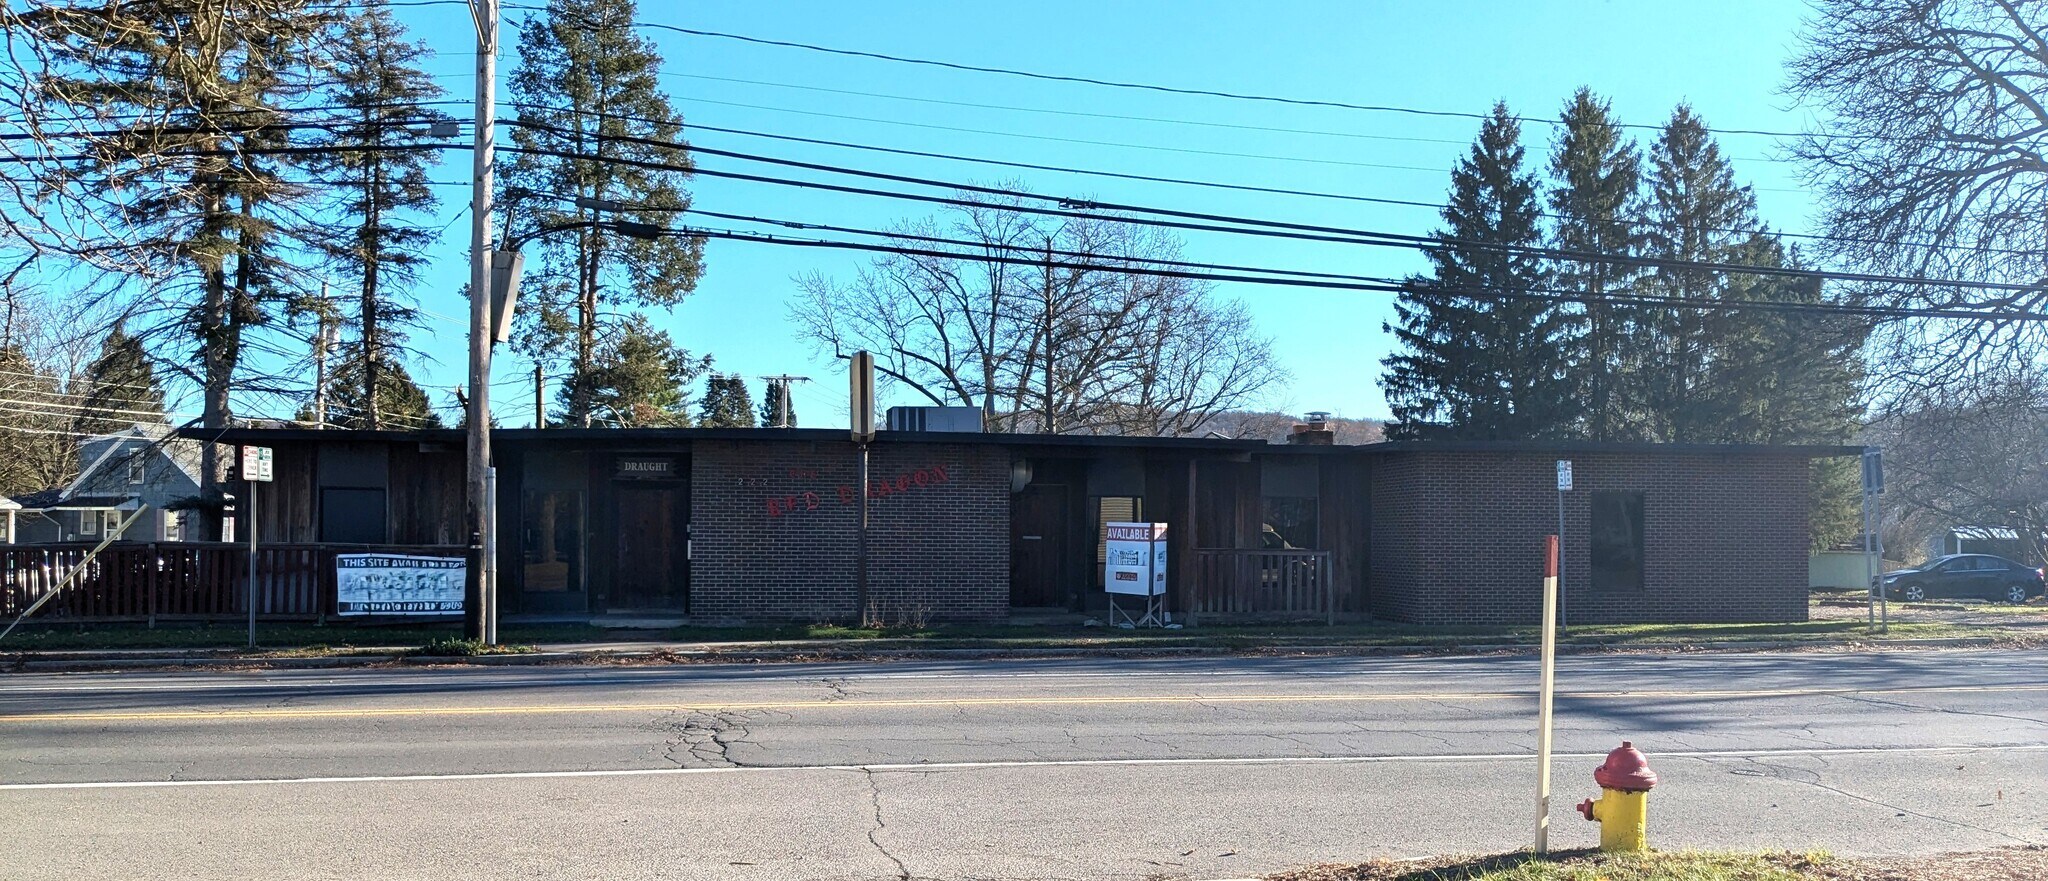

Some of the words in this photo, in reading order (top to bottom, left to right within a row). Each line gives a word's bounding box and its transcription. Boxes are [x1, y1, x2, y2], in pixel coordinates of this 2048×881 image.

[624, 462, 668, 472] DRAUGHT
[1107, 528, 1149, 540] AVAILABLE
[343, 558, 366, 567] THIS
[367, 557, 389, 567] SITE
